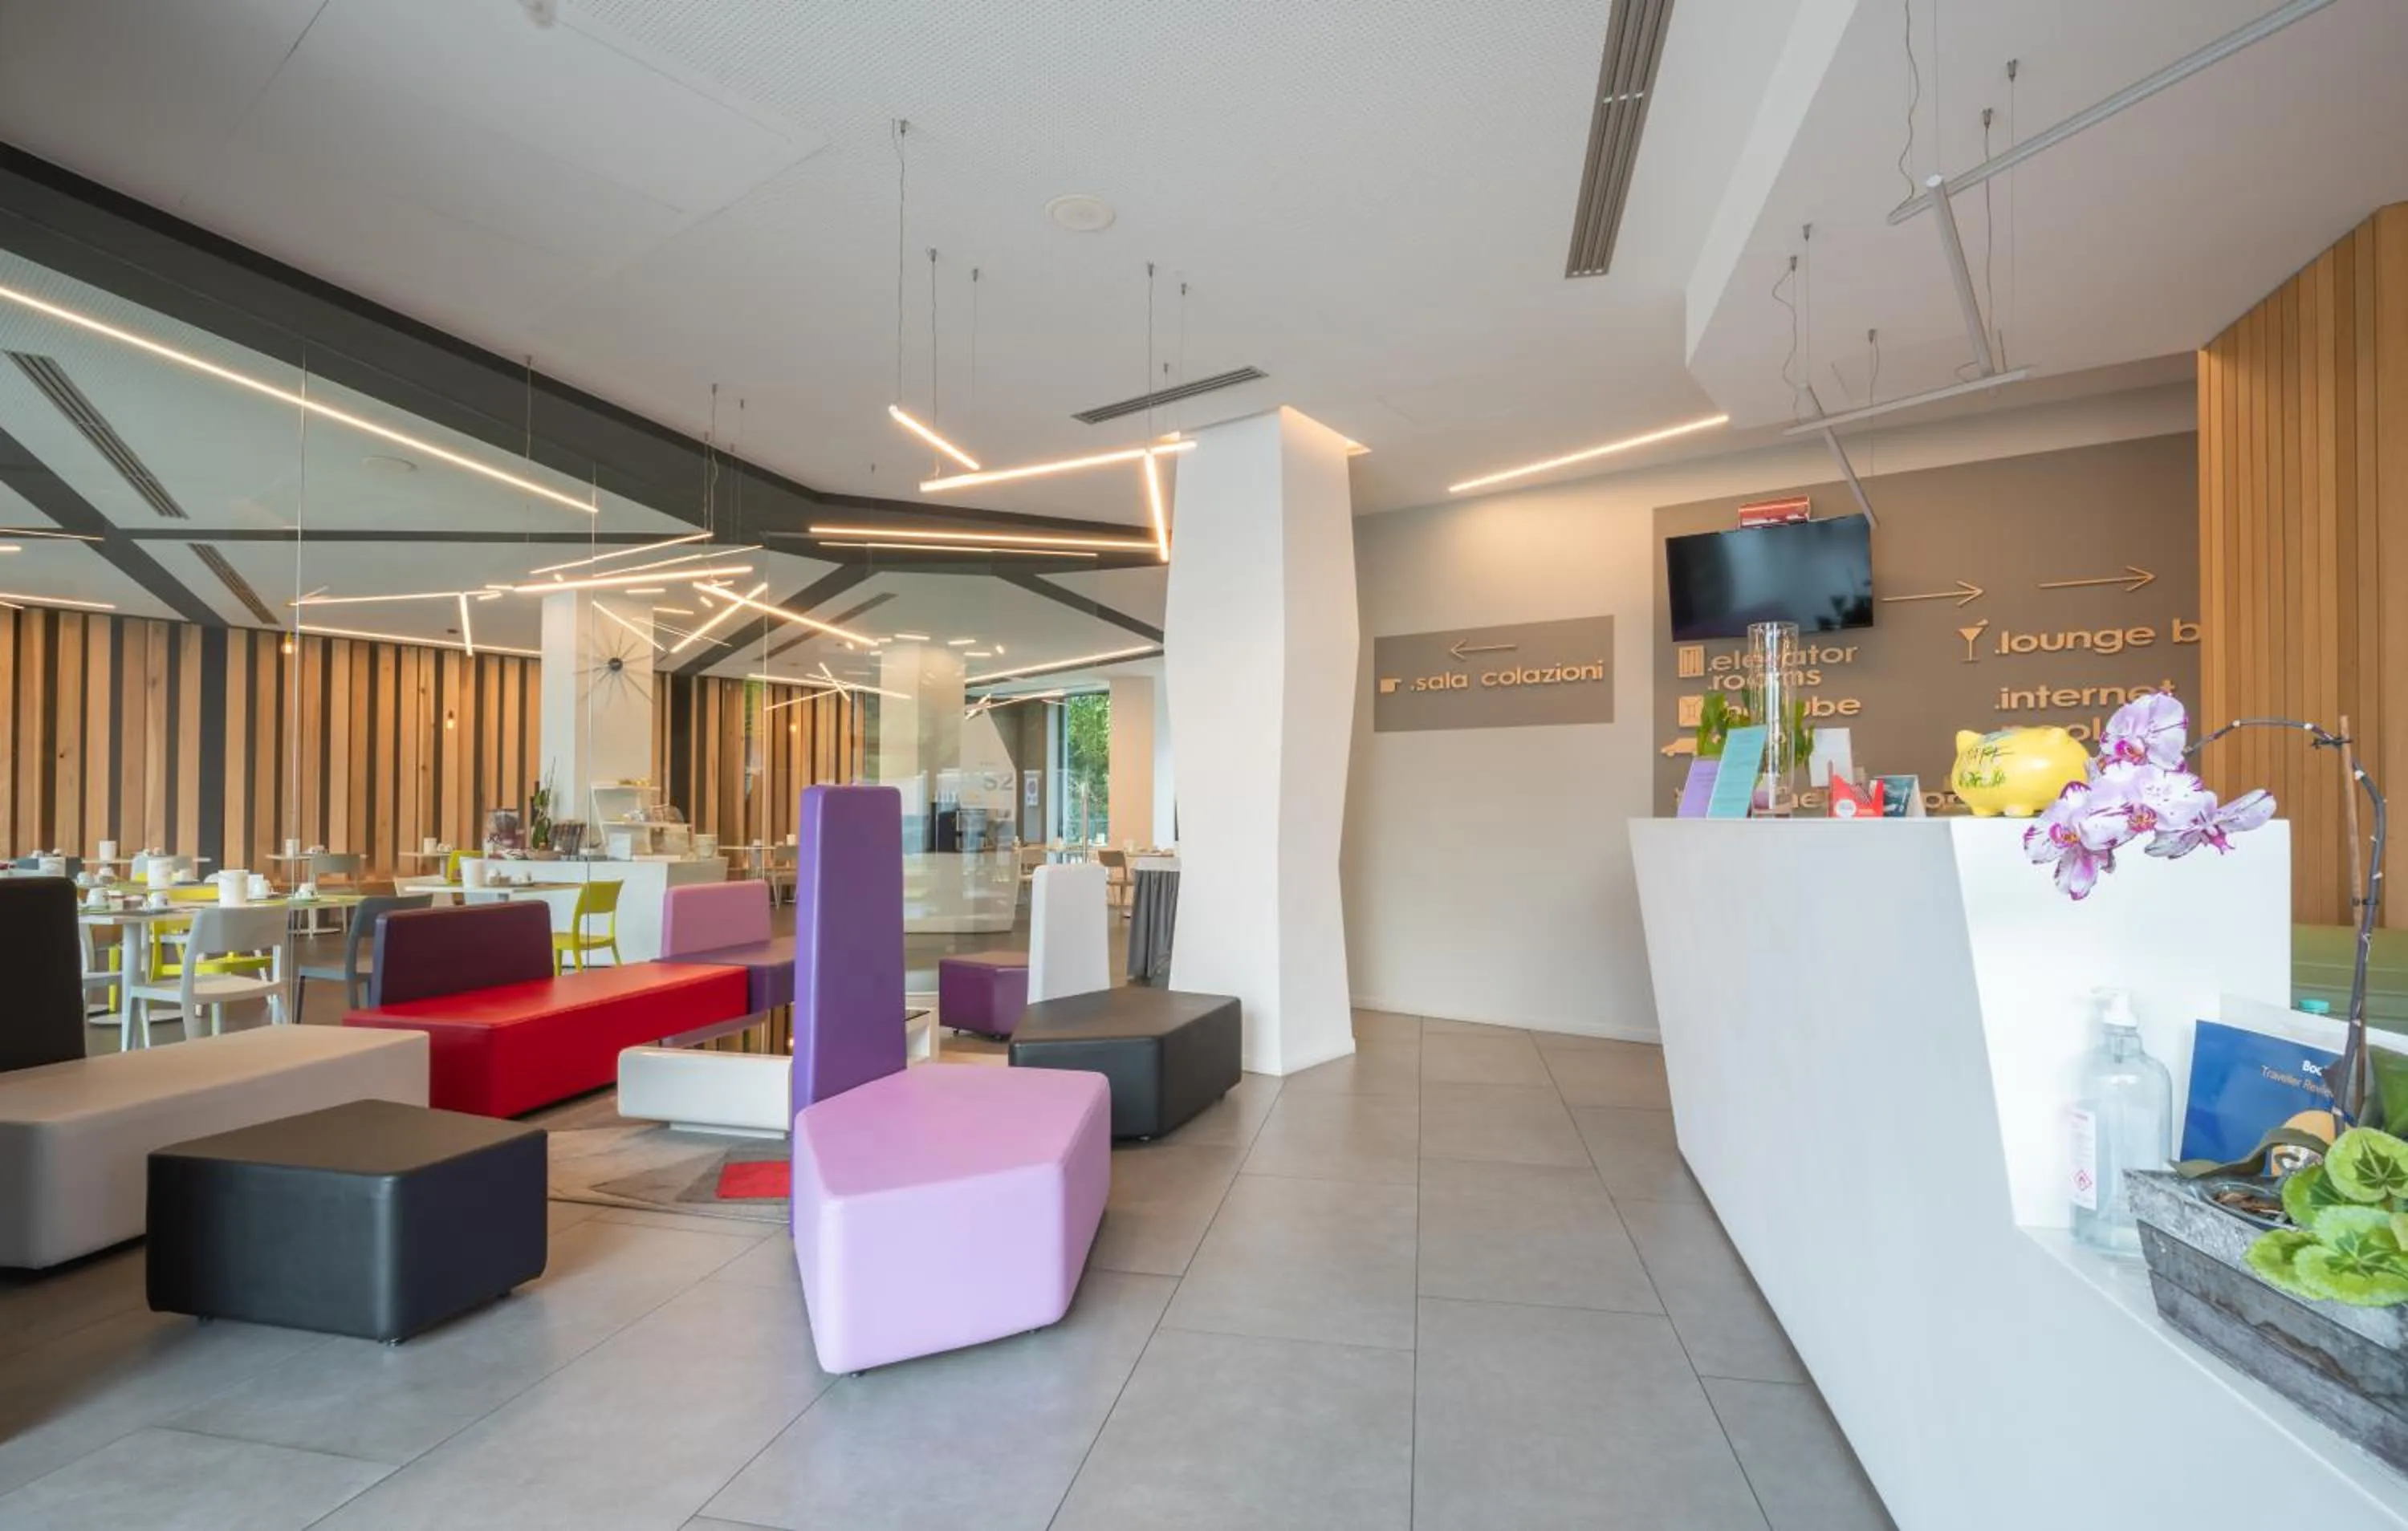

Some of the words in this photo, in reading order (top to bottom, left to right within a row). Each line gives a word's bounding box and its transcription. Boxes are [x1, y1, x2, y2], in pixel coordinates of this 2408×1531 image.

[1994, 626, 2156, 654] .lounge
[1409, 670, 1469, 692] .sala
[1480, 660, 1605, 688] colazioni
